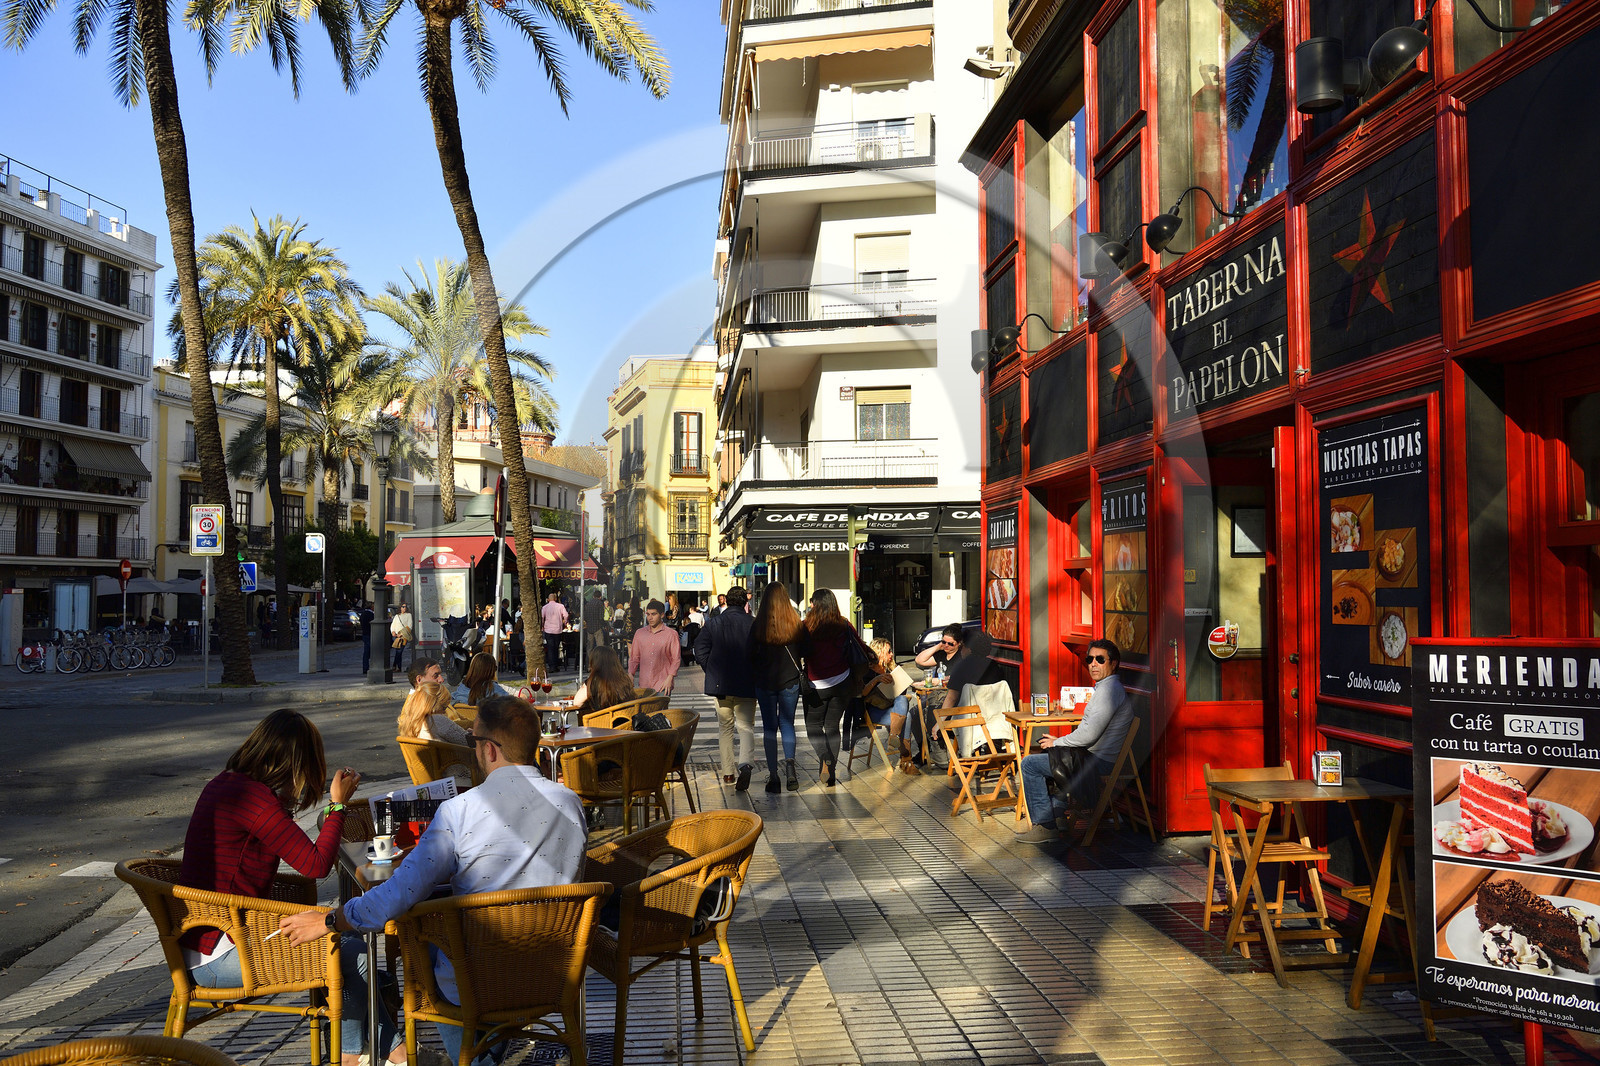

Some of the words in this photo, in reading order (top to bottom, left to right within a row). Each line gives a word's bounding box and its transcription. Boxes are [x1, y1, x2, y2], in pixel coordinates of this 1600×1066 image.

[1167, 236, 1285, 331] TABERNA
[1213, 318, 1232, 350] EL
[1173, 334, 1285, 413] PAPELON
[1324, 441, 1378, 473] NUESTRAS
[1383, 431, 1422, 461] TAPAS
[1325, 473, 1361, 483] TABERNA
[766, 513, 819, 522] CAFE
[794, 542, 820, 552] CAFE
[823, 542, 836, 552] DE
[539, 569, 582, 578] TABACOS
[1429, 654, 1600, 688] MERIENDA
[1347, 671, 1372, 689] Sabor
[1373, 678, 1401, 693] casero
[1430, 687, 1497, 695] TABERNA
[1449, 713, 1493, 731] Café
[1509, 718, 1579, 736] GRATIS
[1430, 738, 1459, 750] con
[1462, 738, 1479, 752] tu
[1483, 739, 1522, 755] tarta
[1527, 744, 1538, 755] o
[1425, 966, 1445, 983] Te
[1447, 976, 1513, 996] esperamos
[1515, 986, 1551, 1003] para
[1508, 1004, 1527, 1012] válida
[1557, 1020, 1579, 1030] cortado
